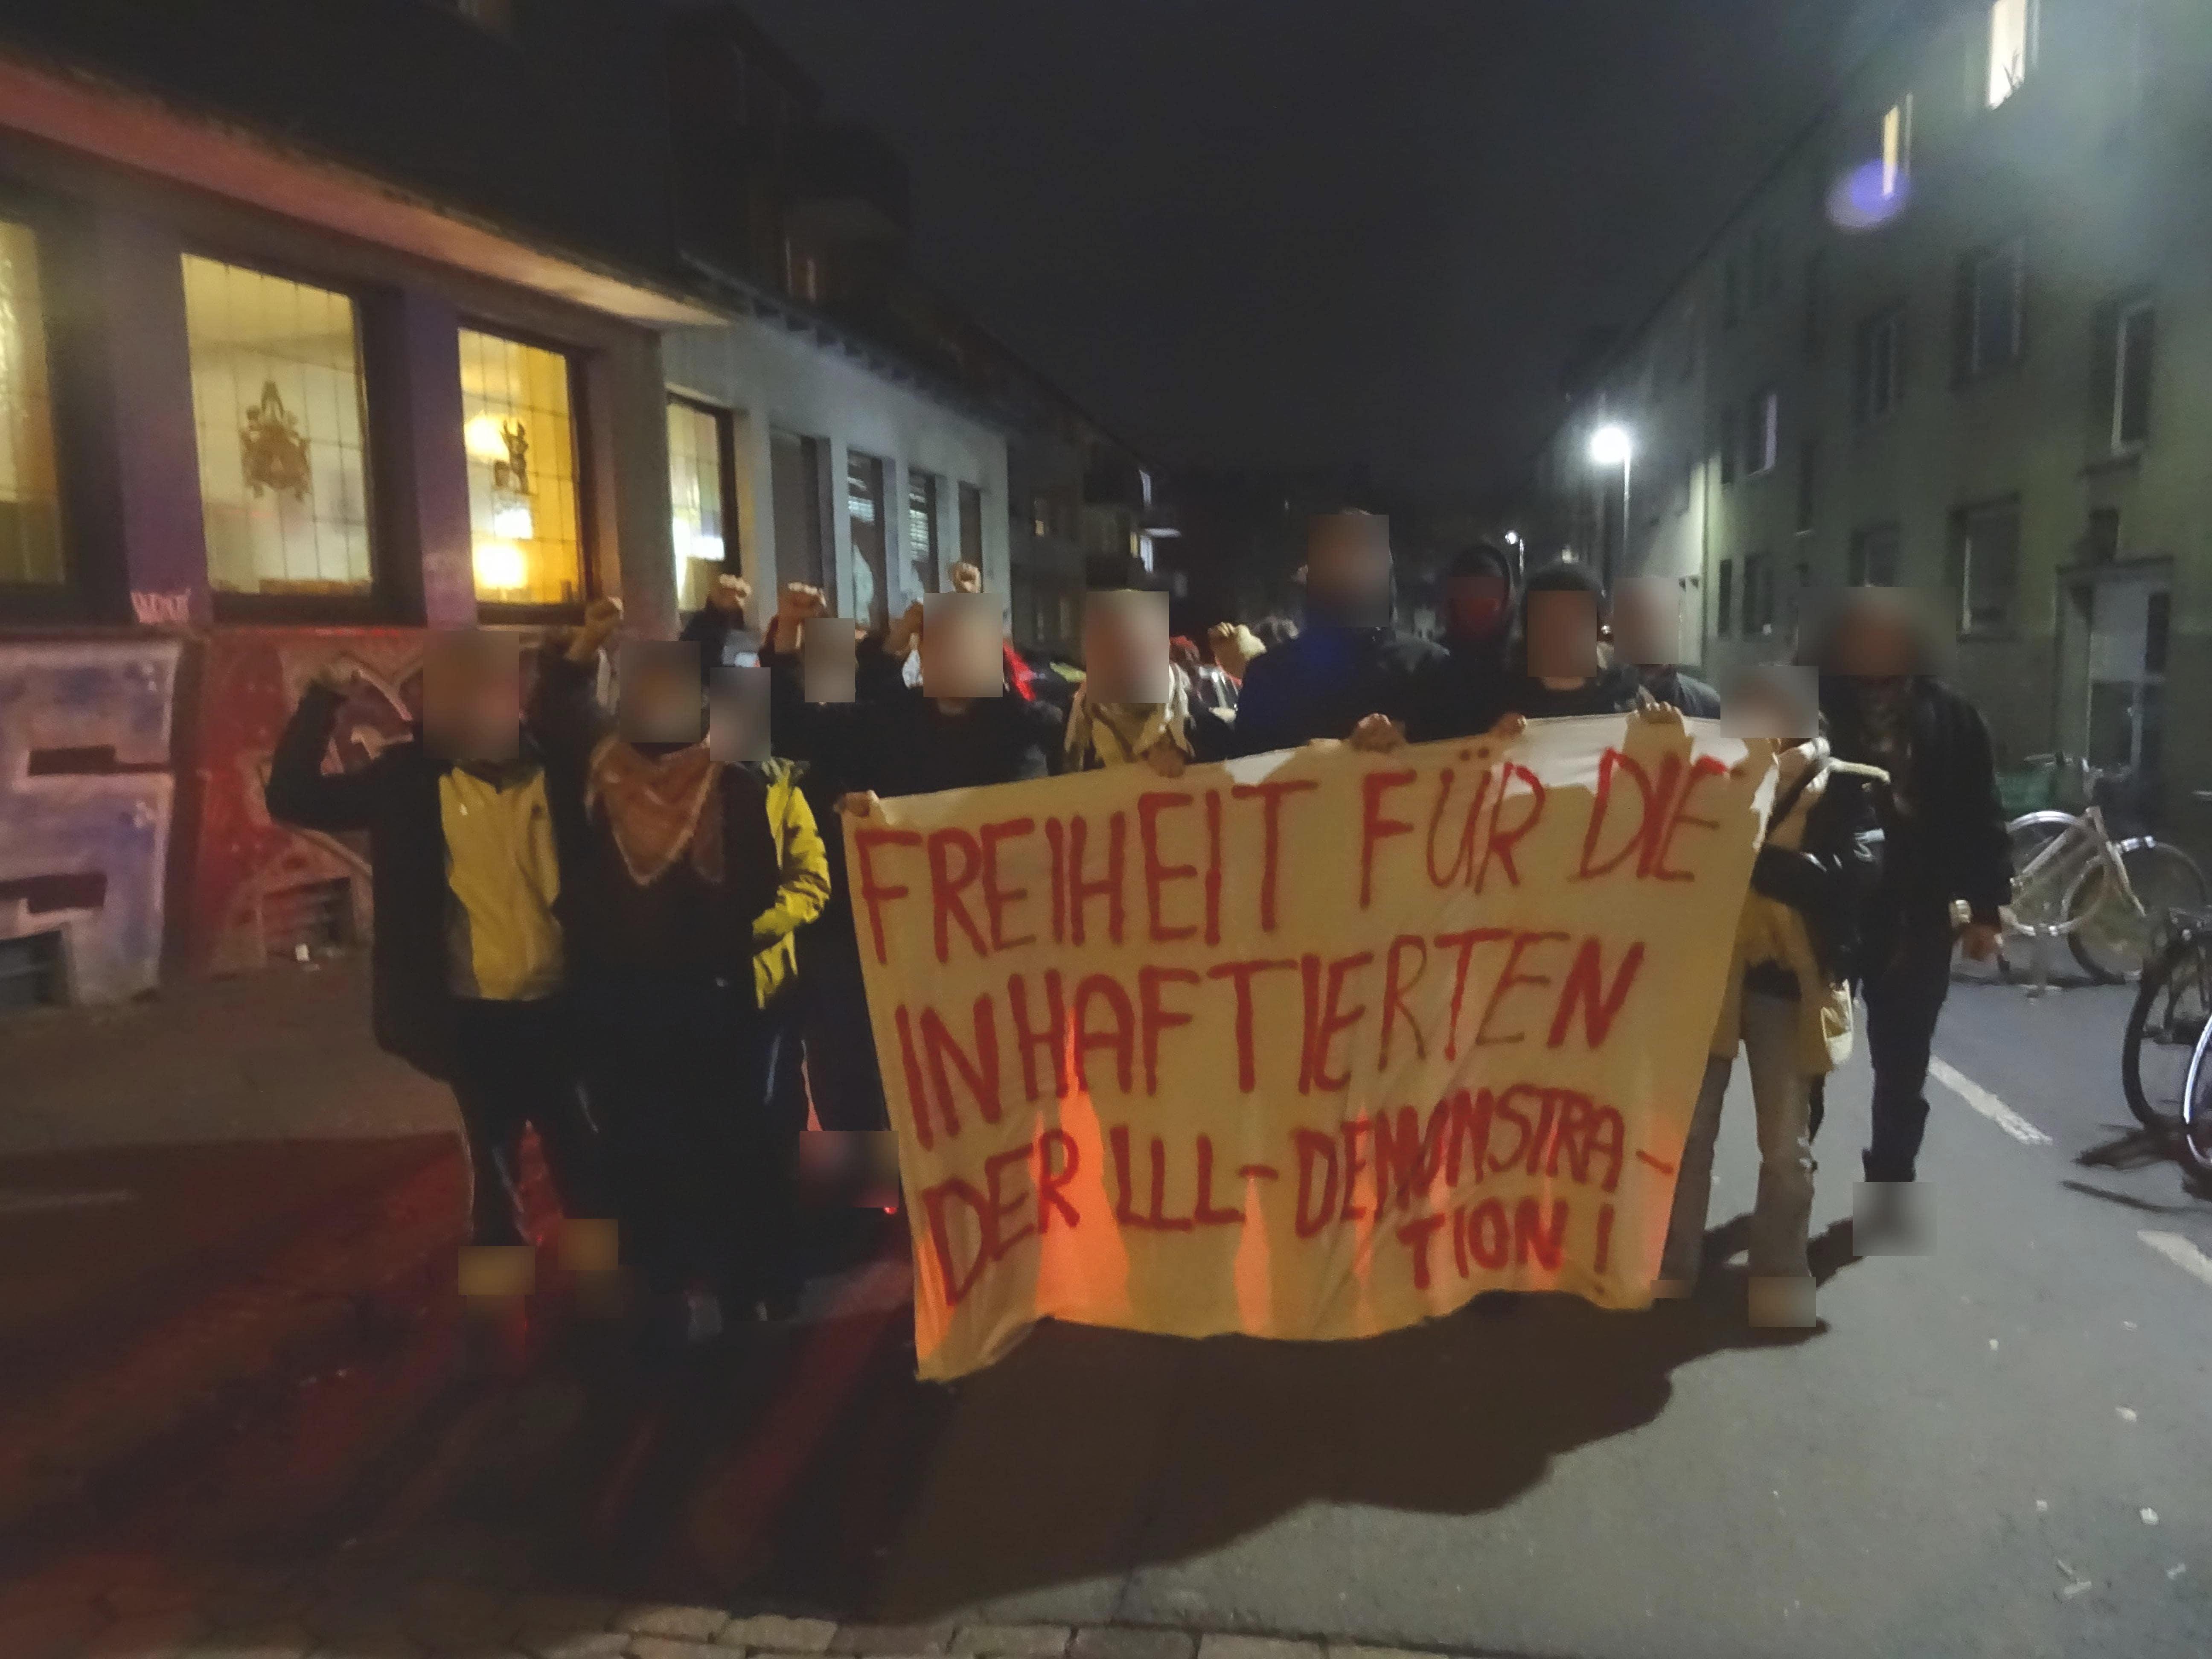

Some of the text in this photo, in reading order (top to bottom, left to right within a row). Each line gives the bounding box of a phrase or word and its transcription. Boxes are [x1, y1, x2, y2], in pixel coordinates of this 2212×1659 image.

[855, 747, 1744, 965] FREIHEIT FÜR DIE
[895, 928, 1645, 1152] INHAFTIERTEN
[922, 1129, 1080, 1307] DER
